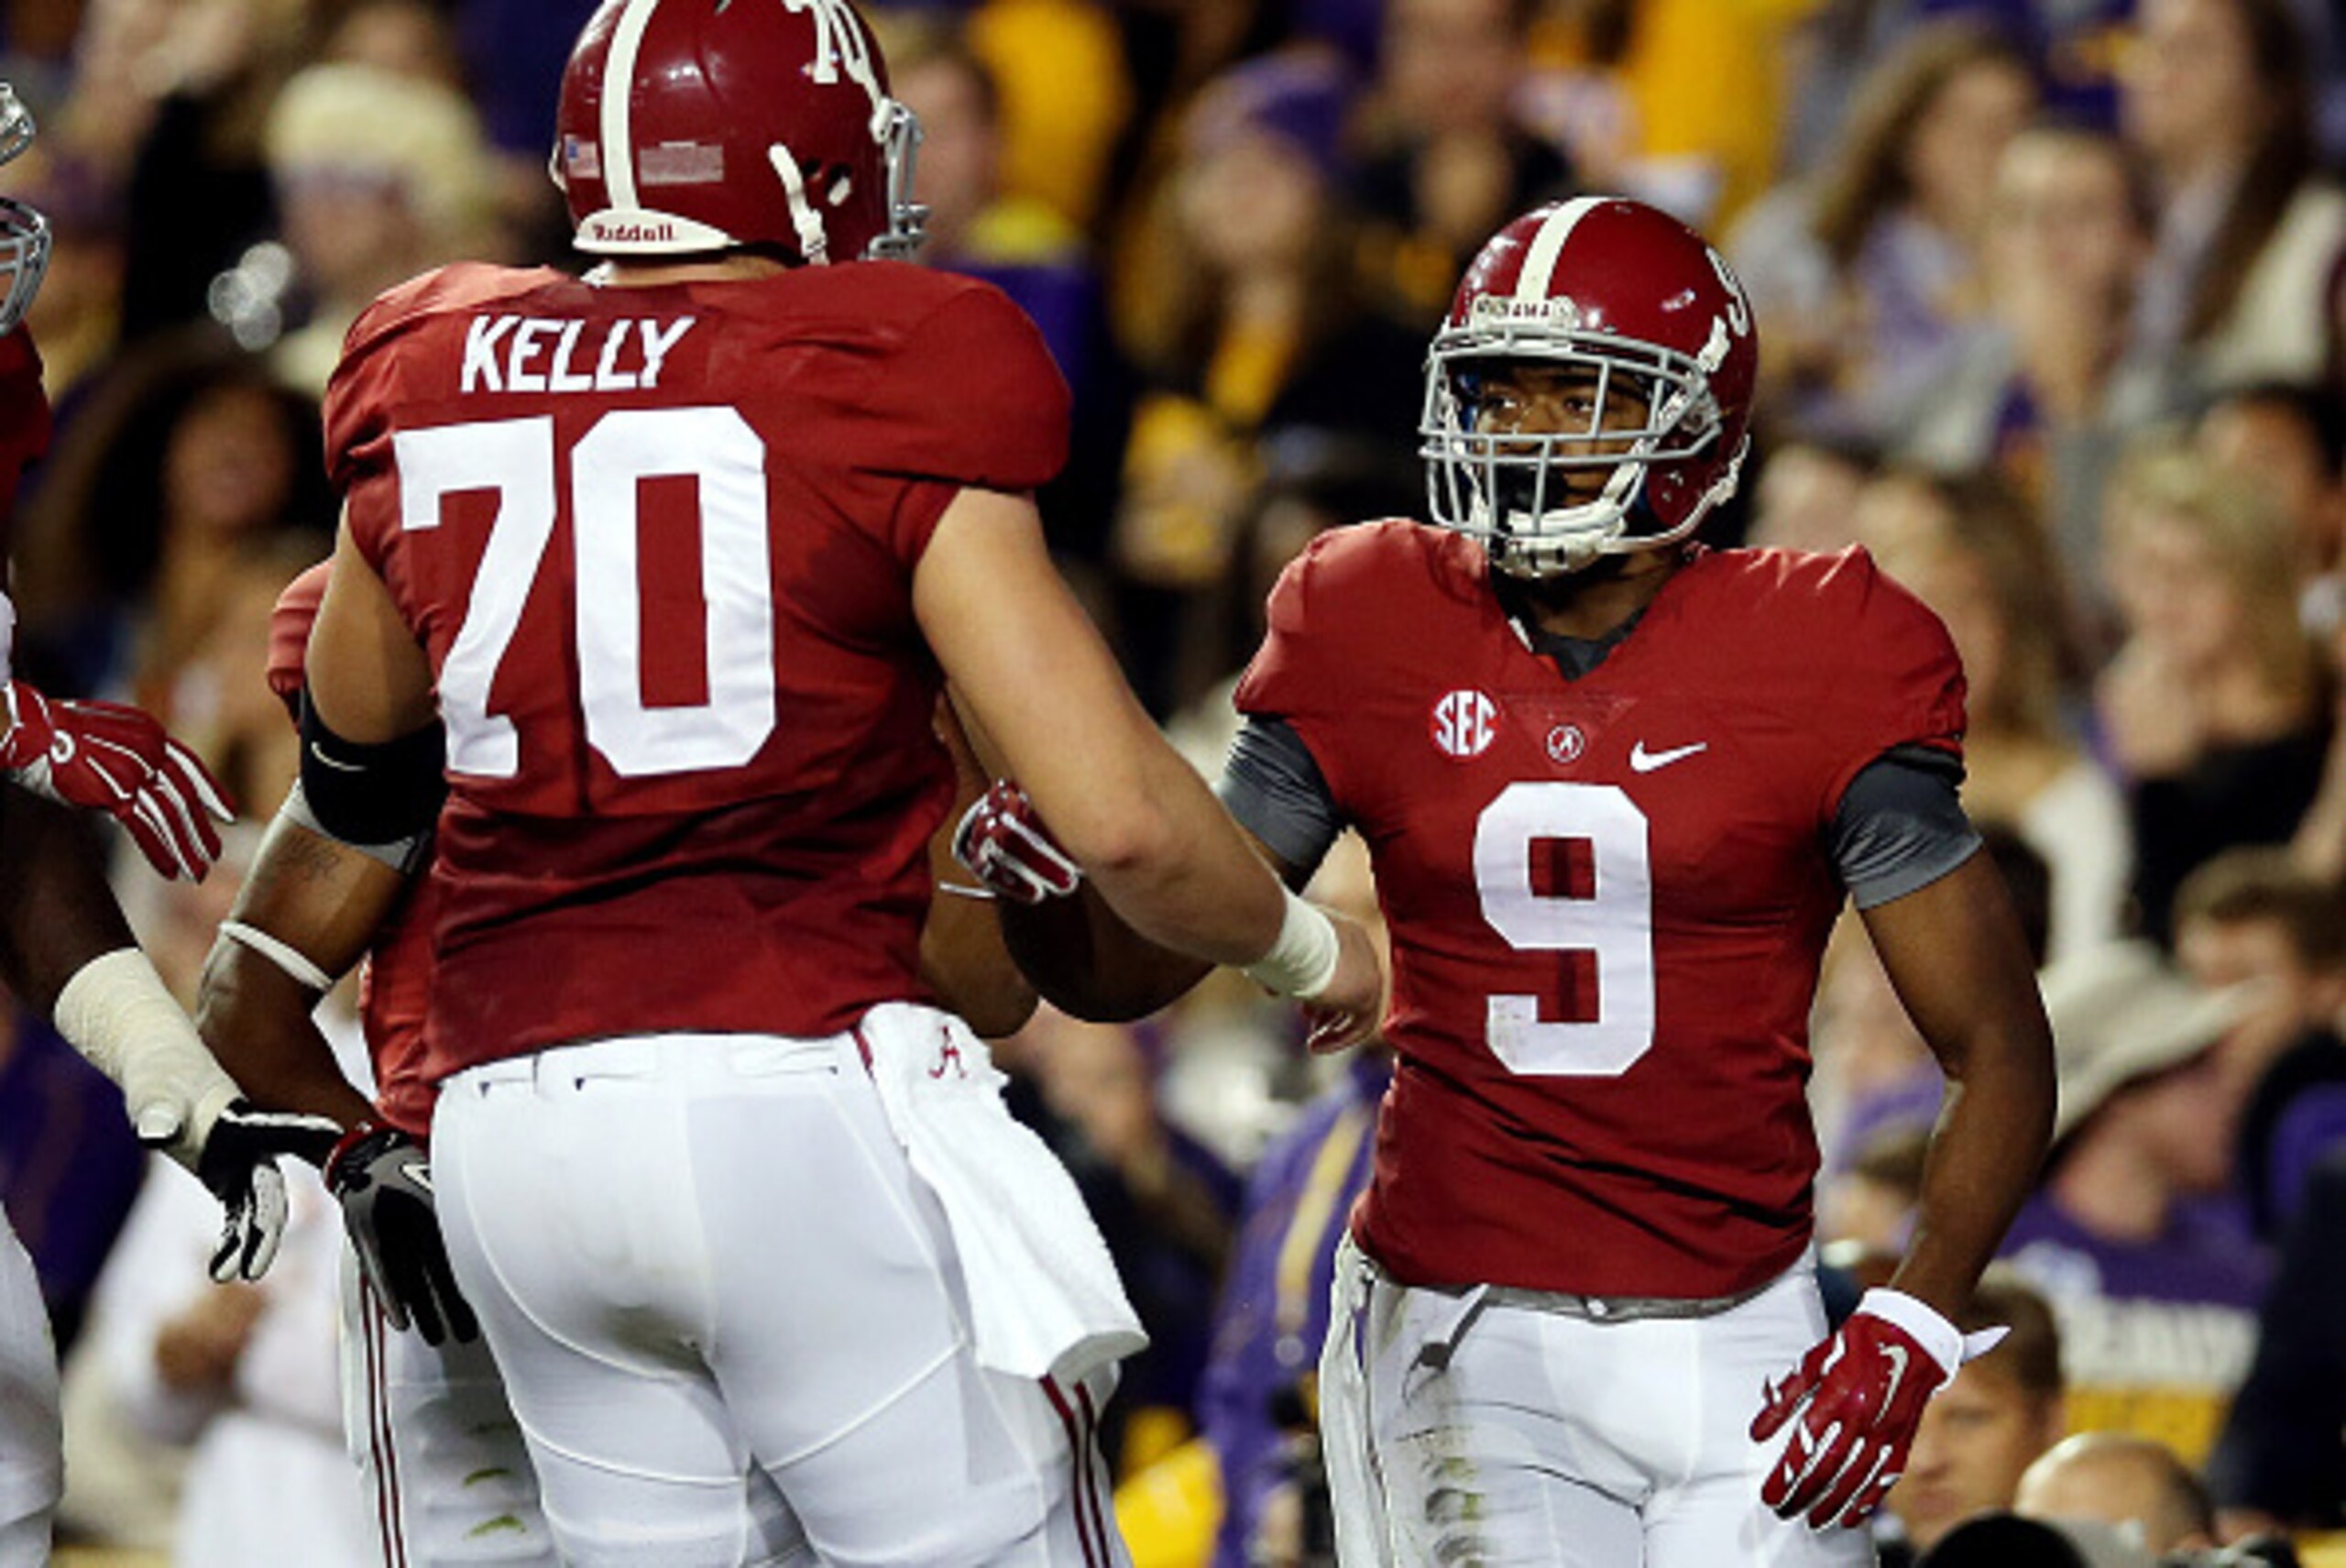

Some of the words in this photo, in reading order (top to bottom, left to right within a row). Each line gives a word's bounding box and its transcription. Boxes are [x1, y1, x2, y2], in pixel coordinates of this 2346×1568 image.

[461, 314, 696, 393] KELLY
[392, 404, 777, 779] 70
[1433, 690, 1496, 755] SEC
[1473, 781, 1656, 1076] 9
